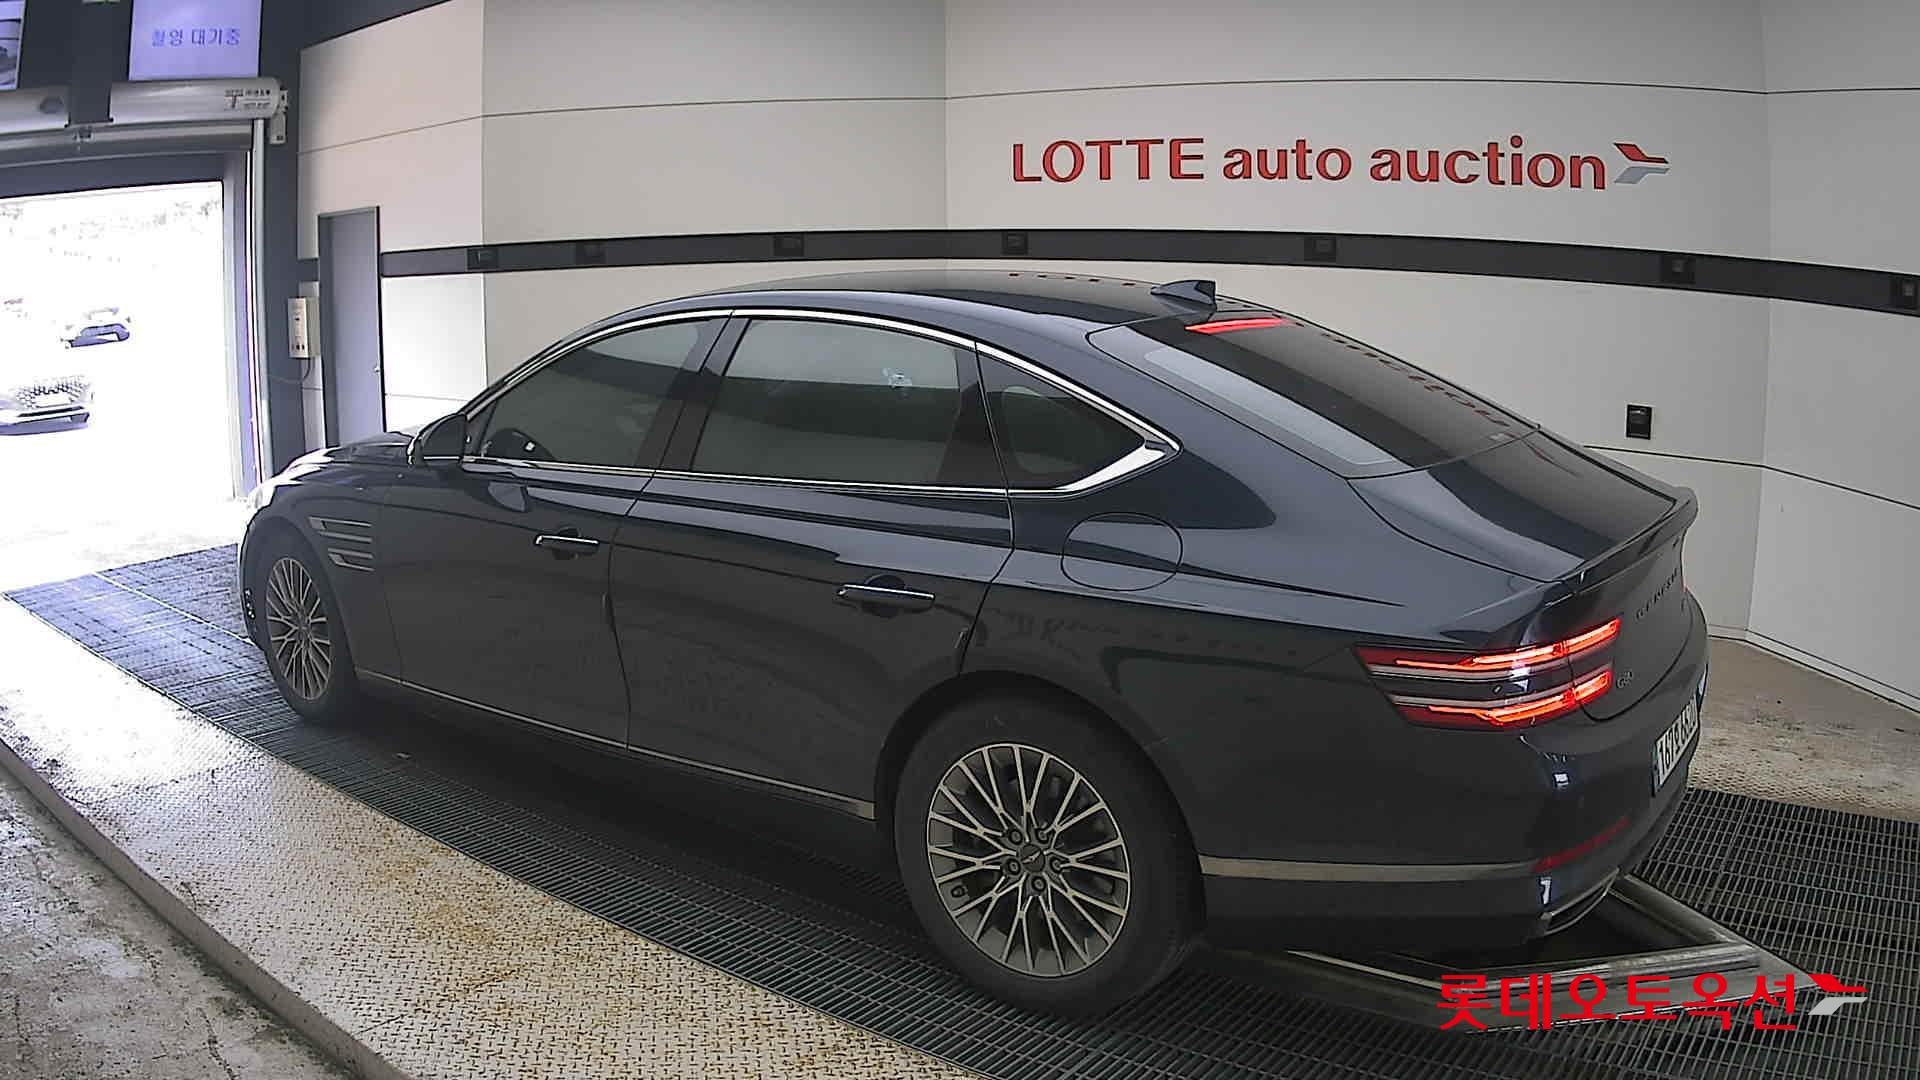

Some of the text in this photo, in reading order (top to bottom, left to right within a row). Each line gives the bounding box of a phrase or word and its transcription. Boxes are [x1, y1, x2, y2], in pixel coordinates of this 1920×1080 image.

[1013, 136, 1607, 190] LOTTE auto auction
